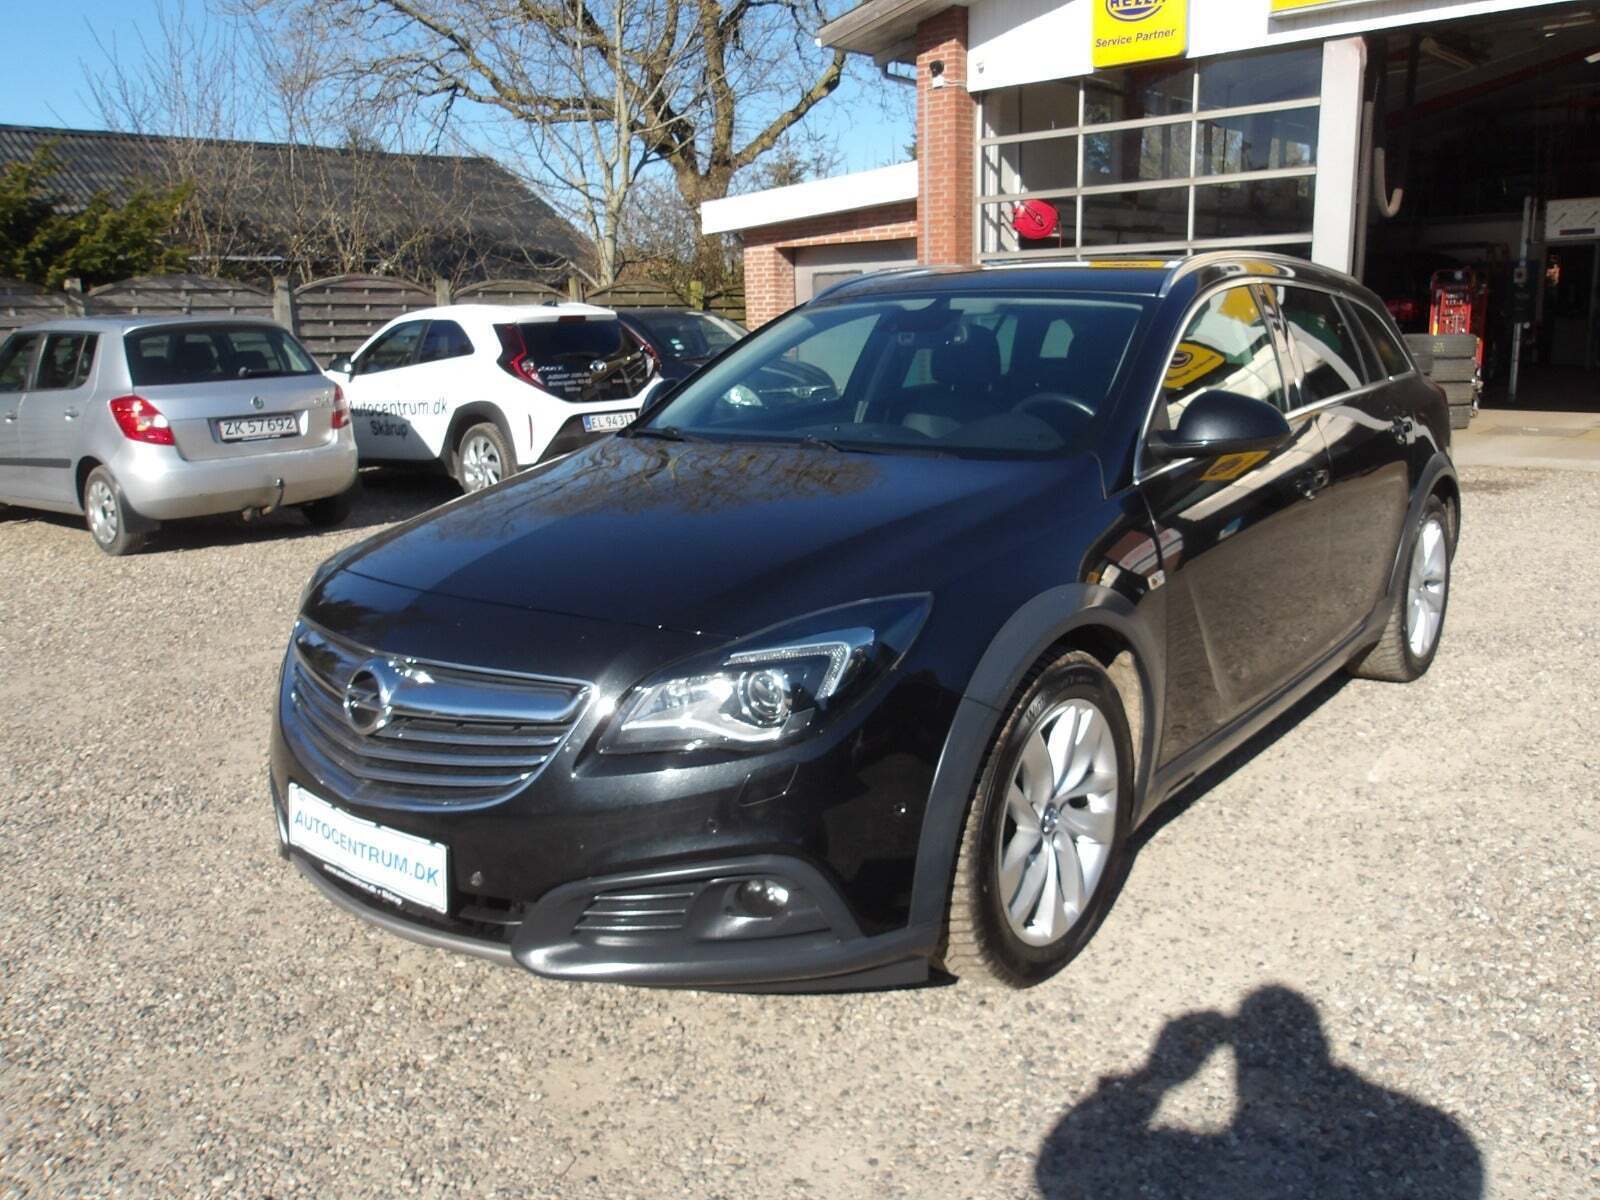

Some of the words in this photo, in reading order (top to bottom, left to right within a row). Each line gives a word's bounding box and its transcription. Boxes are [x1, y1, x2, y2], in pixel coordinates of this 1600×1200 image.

[1110, 0, 1165, 8] HEL
[1095, 36, 1132, 48] Service
[1135, 28, 1177, 42] Partner
[224, 420, 245, 436] ZK
[247, 416, 294, 434] 57692
[591, 416, 605, 429] EL
[294, 809, 440, 888] AUTOCENTRUM.DK
